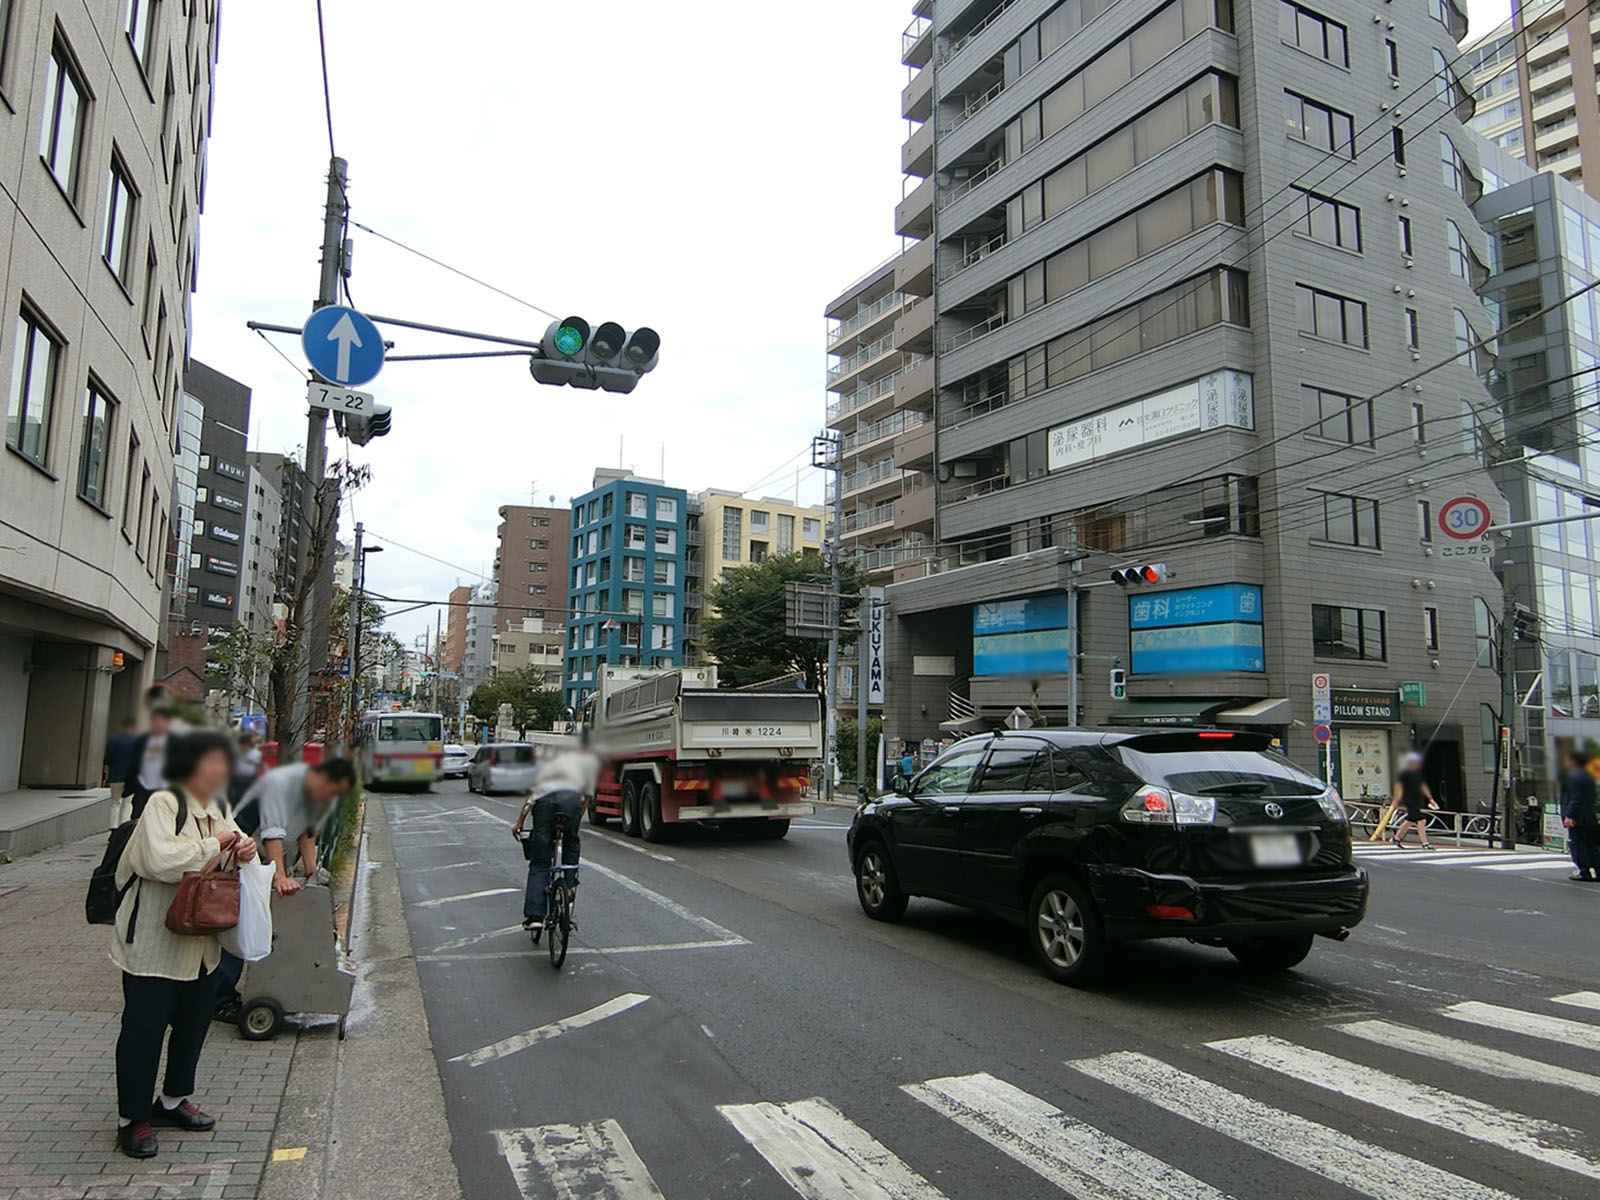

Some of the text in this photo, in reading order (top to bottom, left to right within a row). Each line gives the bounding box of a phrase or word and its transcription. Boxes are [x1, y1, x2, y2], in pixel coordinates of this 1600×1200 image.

[1207, 389, 1218, 427] 泌尿器
[1053, 416, 1107, 447] 泌尿器科
[1450, 508, 1479, 529] 30
[1442, 544, 1491, 557] ここから
[1134, 597, 1170, 621] 歯科
[1240, 591, 1256, 613] 歯
[1334, 705, 1364, 716] PILLOW
[1365, 706, 1391, 717] STAND
[758, 727, 782, 737] 1224
